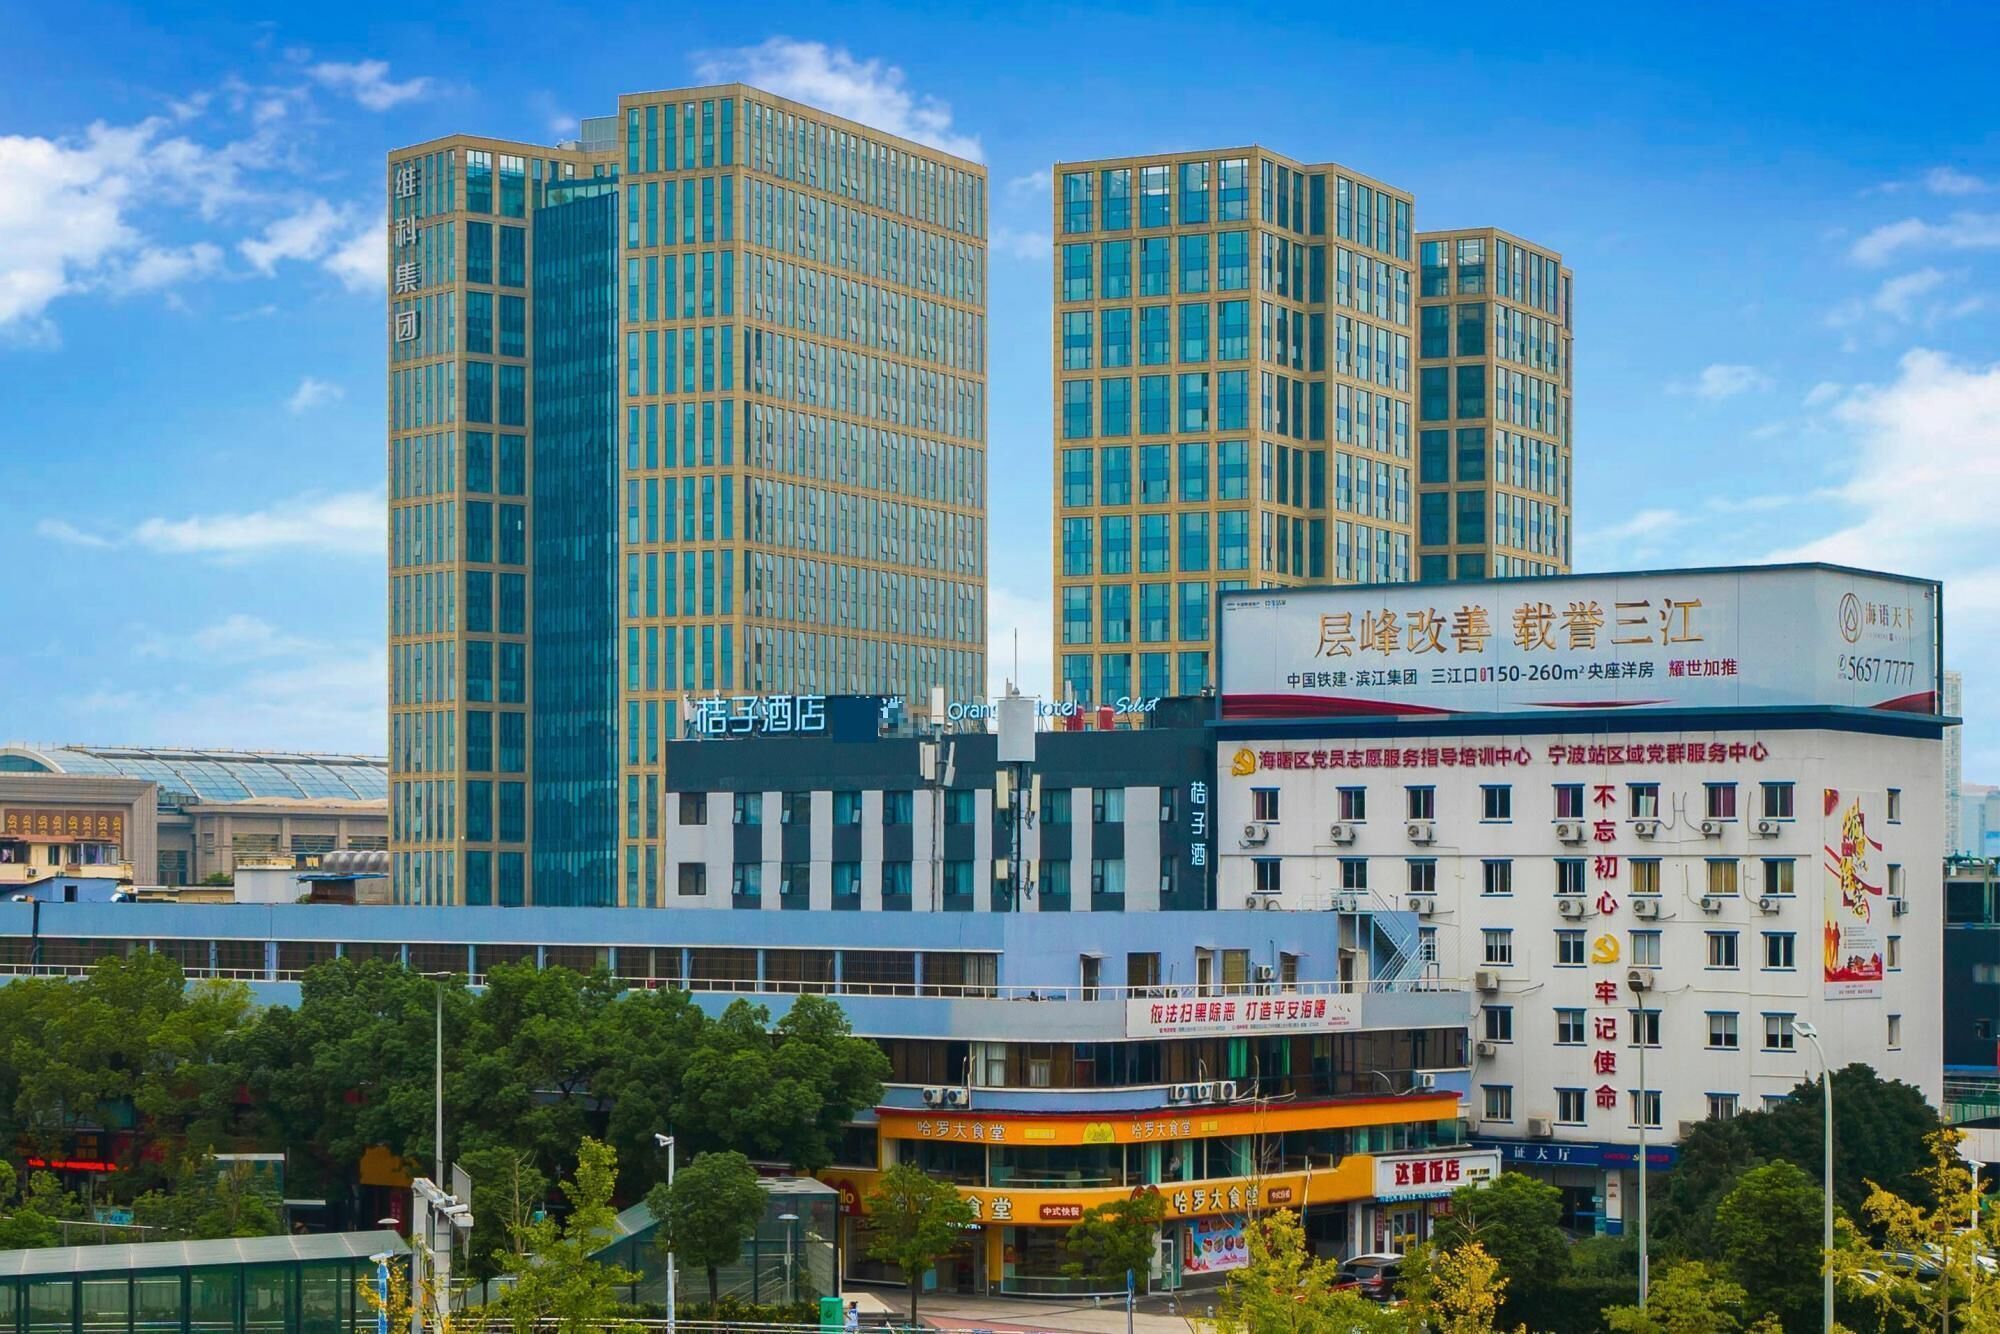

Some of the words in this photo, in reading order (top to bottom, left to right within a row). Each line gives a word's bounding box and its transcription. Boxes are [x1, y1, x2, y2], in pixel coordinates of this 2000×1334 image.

[1315, 604, 1492, 658] 层峰改善
[1512, 598, 1704, 652] 载誉三江
[1865, 601, 1914, 629] 海语天下
[1668, 658, 1738, 678] 耀世加推
[697, 696, 826, 733] 桔子酒店
[948, 702, 998, 721] Orang
[1115, 697, 1160, 716] Select
[1258, 747, 1532, 771] 海曙区党员志愿服务指导培训中心
[1548, 742, 1769, 766] 宁波站区域党群服务中心
[1593, 785, 1618, 914] 不忘初心
[1150, 1002, 1235, 1024] 依法扫黑除恶
[1245, 999, 1326, 1021] 打造平安海曙
[1594, 979, 1618, 1110] 牢记使命
[917, 1120, 1006, 1141] 哈罗大食堂
[1132, 1119, 1192, 1139] 哈罗大食堂
[1043, 1207, 1080, 1216] 中式快餐
